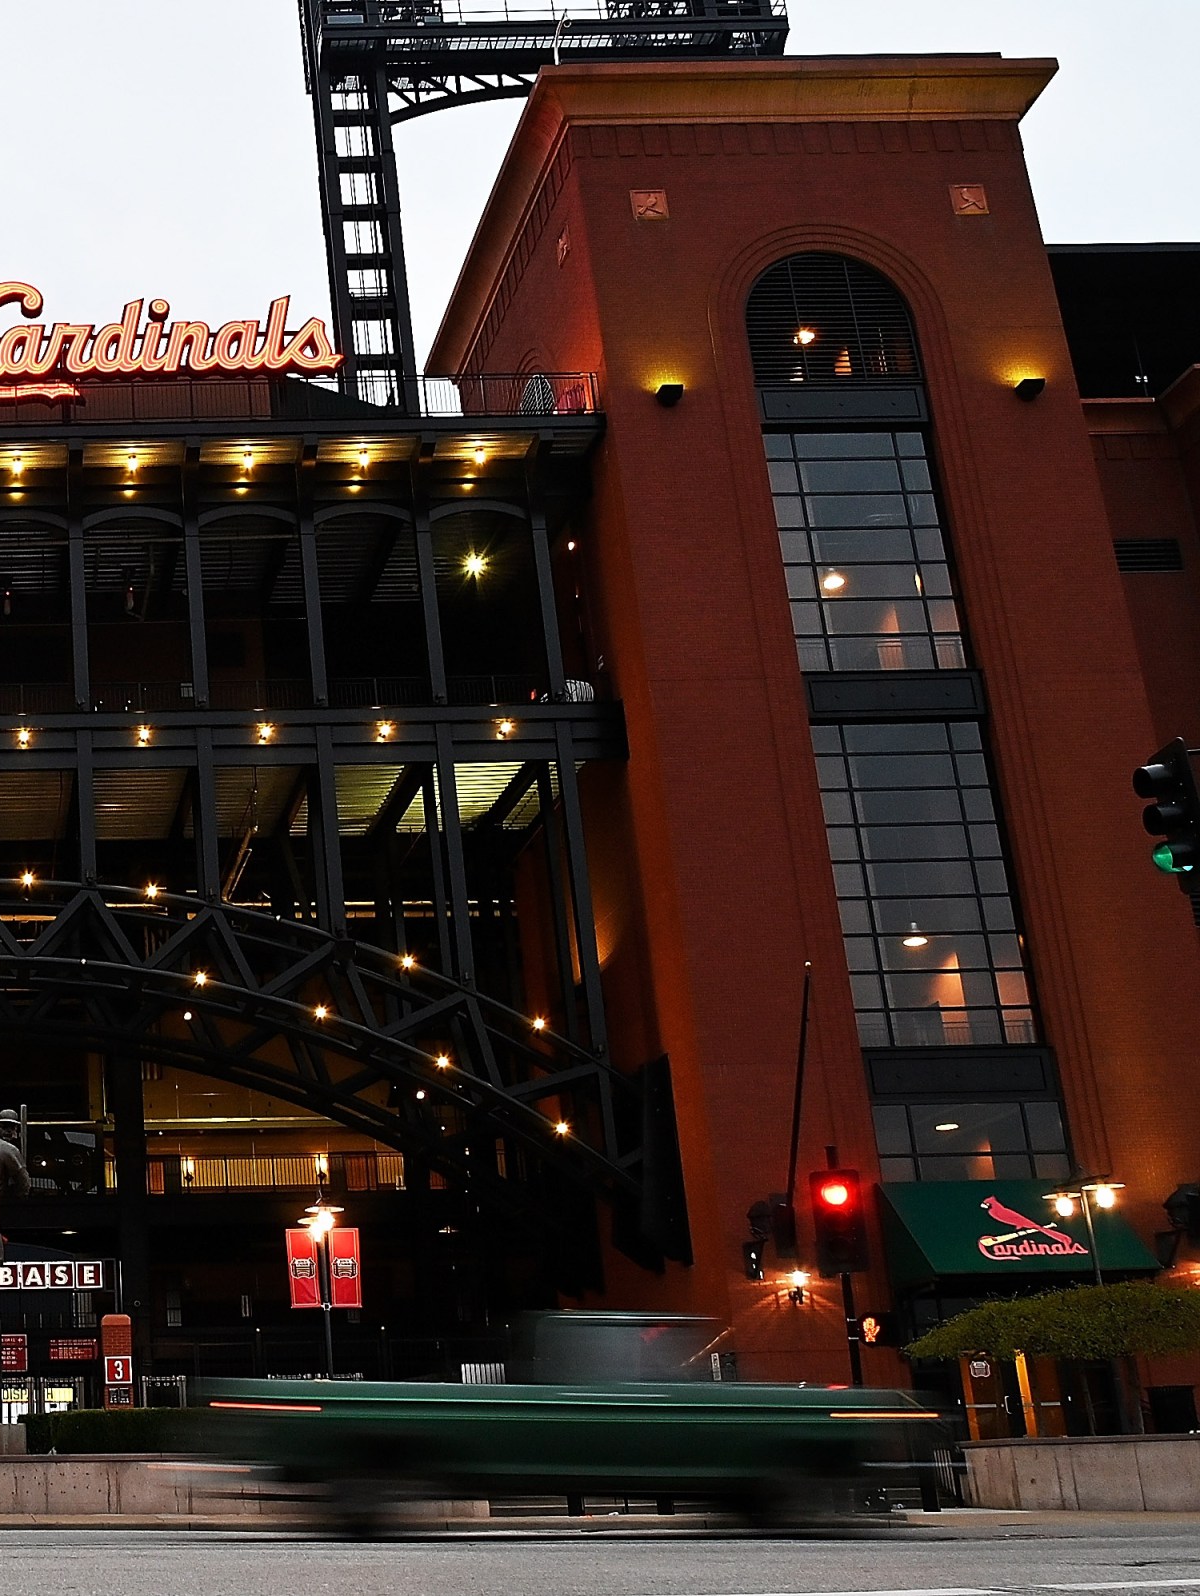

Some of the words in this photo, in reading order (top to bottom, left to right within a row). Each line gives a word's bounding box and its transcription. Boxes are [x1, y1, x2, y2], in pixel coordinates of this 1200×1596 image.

[978, 1235, 1089, 1261] Cardinals
[0, 1265, 96, 1286] BASE
[113, 1360, 124, 1380] 3
